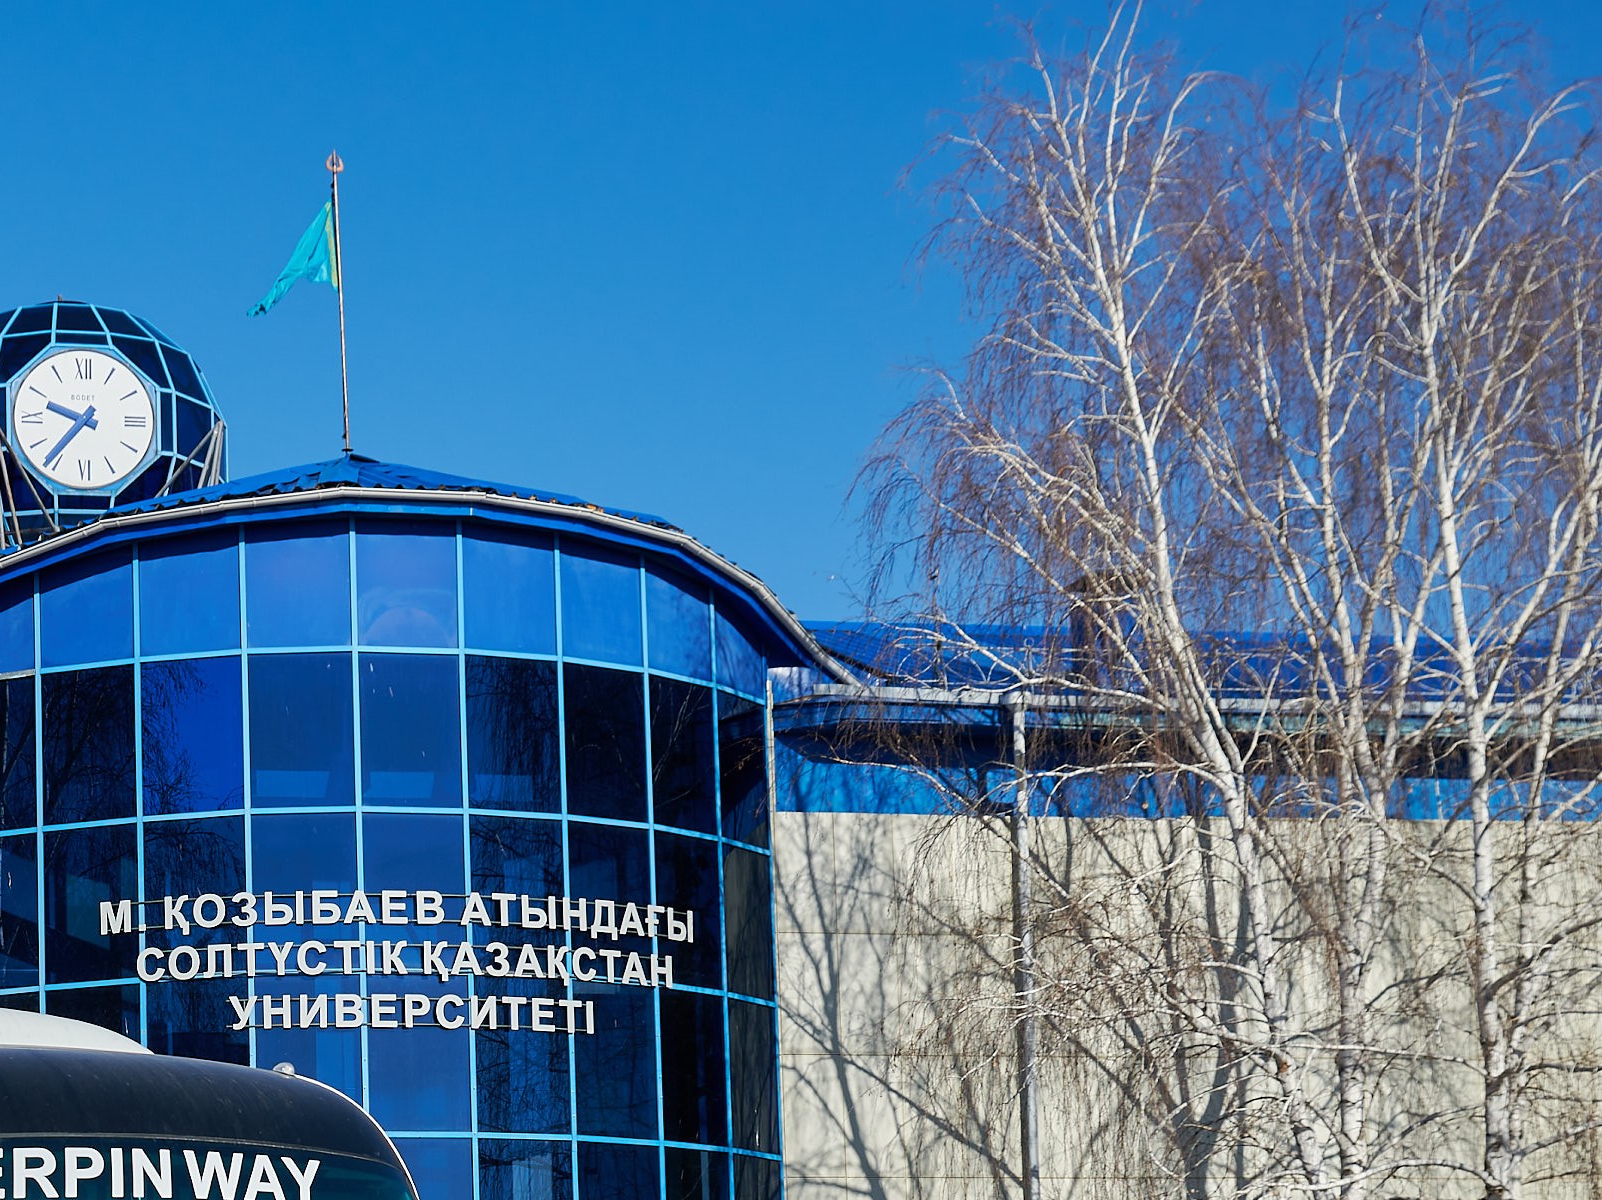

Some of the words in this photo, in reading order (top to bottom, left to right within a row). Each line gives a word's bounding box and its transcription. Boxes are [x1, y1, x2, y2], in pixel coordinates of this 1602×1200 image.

[99, 899, 147, 936] М.
[163, 890, 445, 936] ҚОЗЫБАЕВ
[460, 891, 694, 943] АТЫНДАҒЫ
[136, 940, 409, 982] СОЛТҮСТІК
[423, 940, 673, 988] ҚАЗАҚСТАН
[228, 993, 595, 1034] УНИВЕРСИТЕТІ
